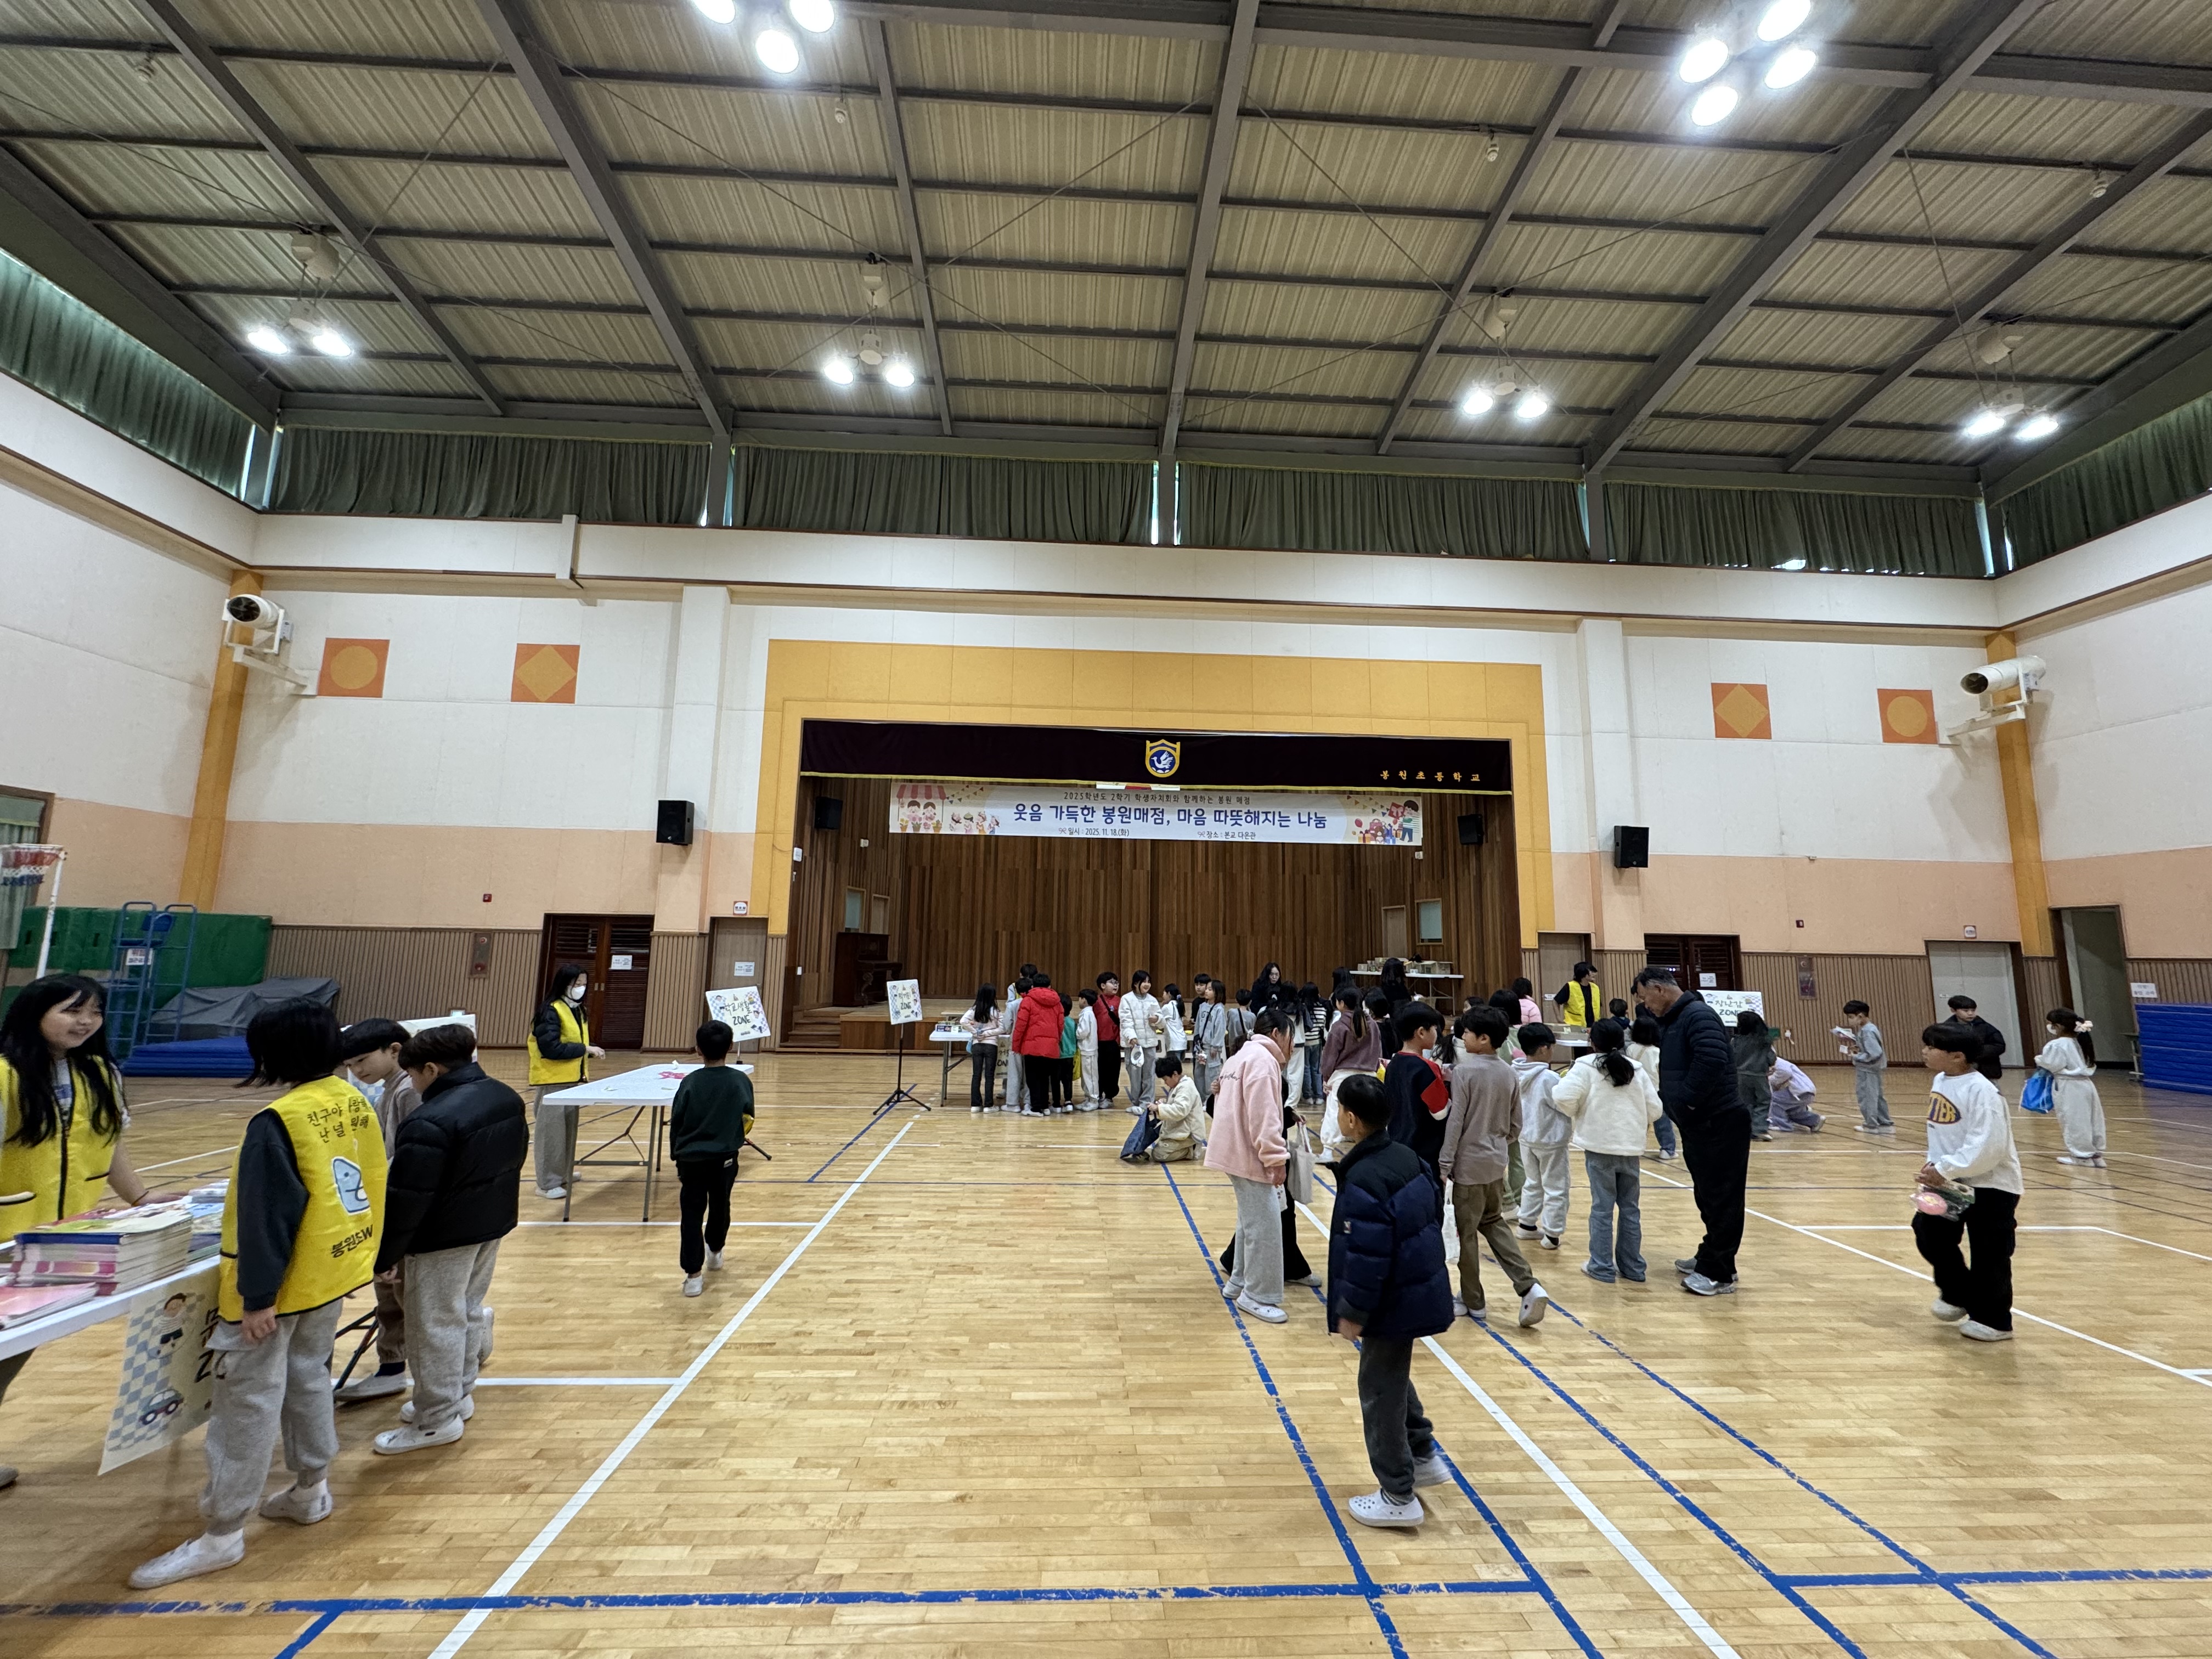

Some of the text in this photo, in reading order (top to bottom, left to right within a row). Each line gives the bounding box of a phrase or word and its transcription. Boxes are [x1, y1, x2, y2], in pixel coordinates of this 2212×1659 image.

[1064, 792, 1107, 800] 2025학년도
[1111, 793, 1130, 802] 2학기
[1135, 793, 1180, 803] 학생자치회와
[1184, 795, 1214, 804] 함께하는
[1218, 796, 1232, 805] 봉원
[1014, 803, 1327, 829] 웃음 가득한 봉원매점, 마음 따뜻해지는 나눔
[732, 1014, 751, 1025] ZONE
[307, 1103, 343, 1126] 친구야
[319, 1127, 330, 1143] 난
[332, 1121, 346, 1137] 널
